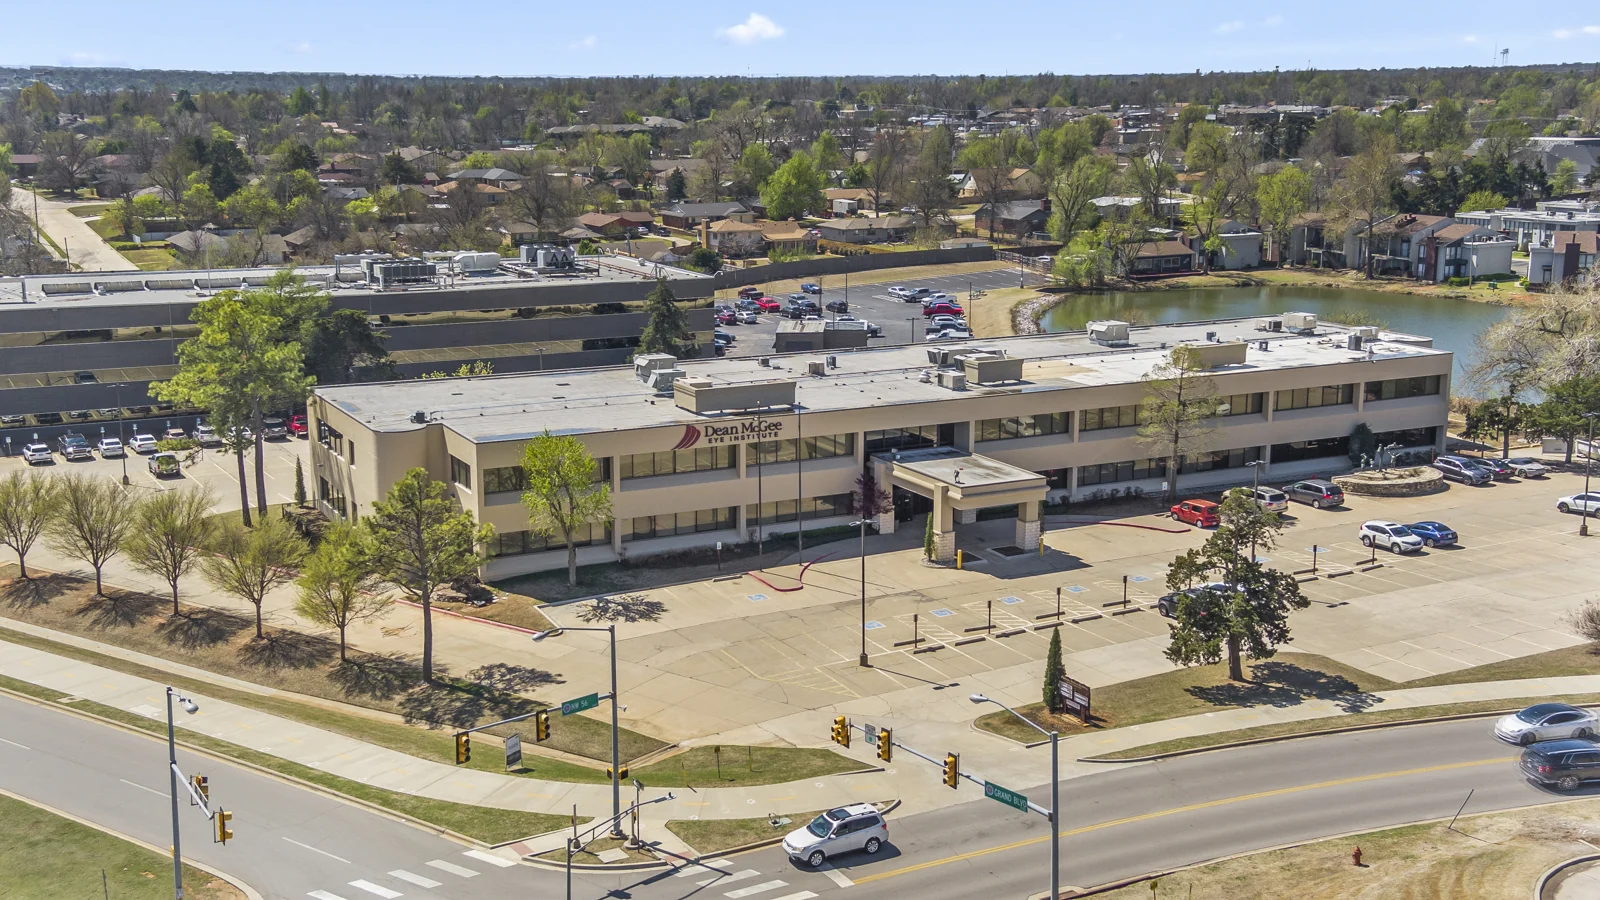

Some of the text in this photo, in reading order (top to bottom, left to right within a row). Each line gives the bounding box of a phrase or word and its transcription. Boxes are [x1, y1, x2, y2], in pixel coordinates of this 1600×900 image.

[704, 420, 782, 437] Dean McGee
[581, 700, 588, 708] 56
[994, 788, 1027, 808] GRAND BLVD
